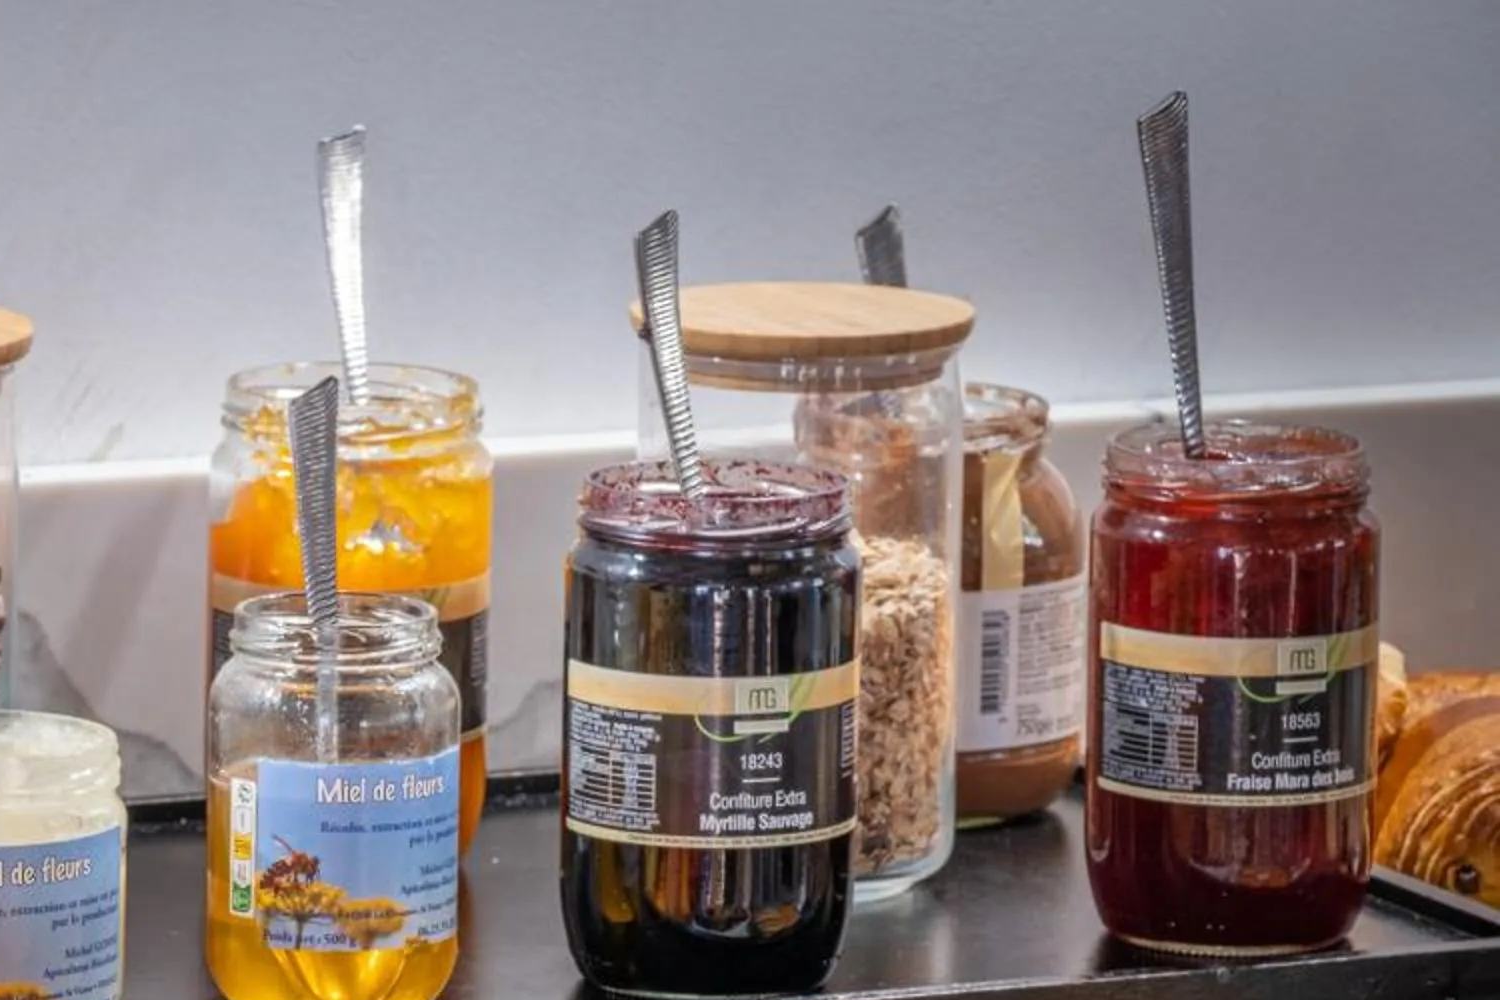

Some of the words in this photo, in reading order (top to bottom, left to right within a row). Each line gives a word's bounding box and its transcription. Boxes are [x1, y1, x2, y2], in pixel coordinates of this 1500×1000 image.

[1281, 712, 1321, 730] 18563
[740, 752, 783, 770] 18243
[1251, 752, 1311, 769] Confiture
[1313, 749, 1340, 767] Extra
[317, 778, 365, 803] Miel
[373, 779, 395, 802] de
[402, 775, 444, 800] fleurs
[1227, 772, 1273, 790] Fraise
[1275, 772, 1310, 789] Mara
[709, 791, 773, 810] Confiture
[775, 789, 807, 807] Extra
[700, 812, 756, 834] Myrtille
[758, 811, 814, 830] Sauvage
[11, 862, 35, 886] de
[42, 856, 92, 884] fleurs
